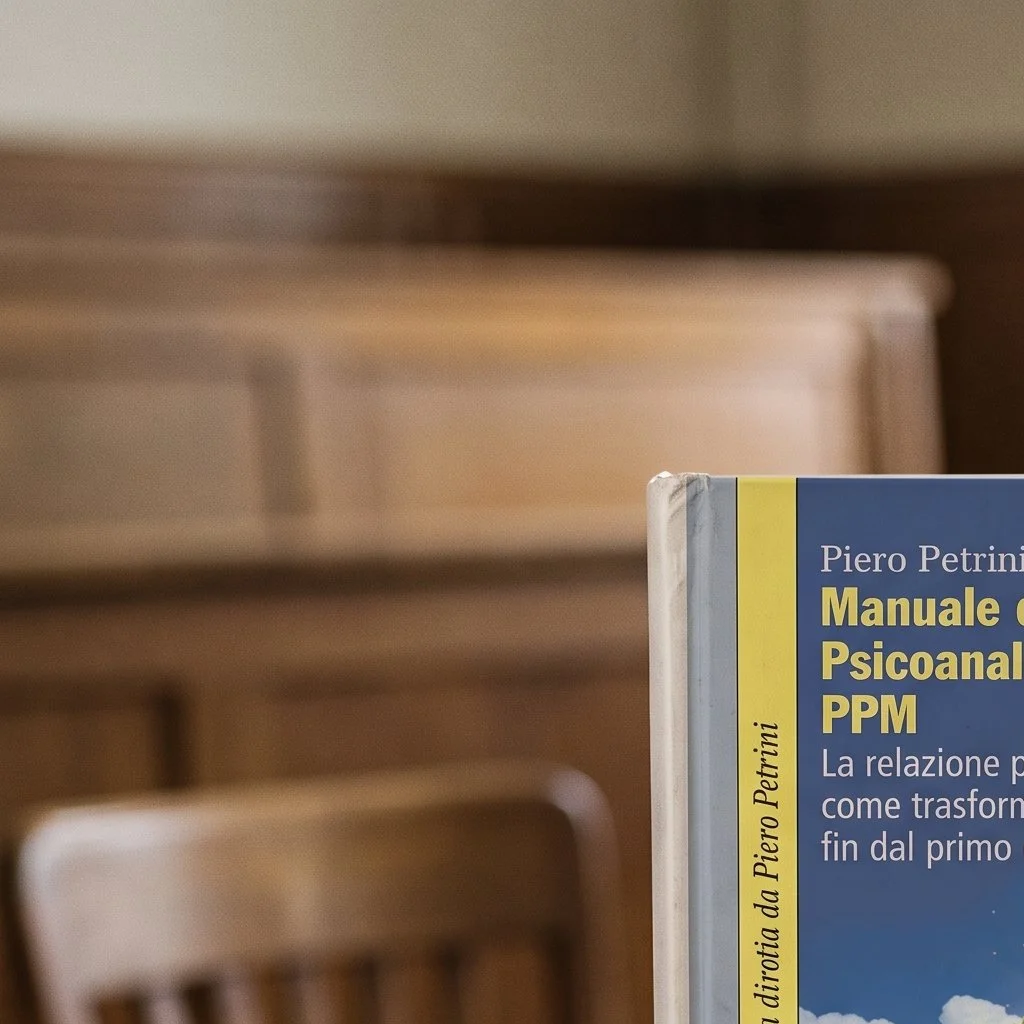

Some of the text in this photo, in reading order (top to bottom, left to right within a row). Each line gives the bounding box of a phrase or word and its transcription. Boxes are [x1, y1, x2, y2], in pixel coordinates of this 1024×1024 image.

[821, 545, 906, 573] Piero
[821, 586, 1000, 627] Manuale
[822, 694, 917, 734] PPM
[752, 721, 779, 809] Petrini
[822, 748, 854, 778] La
[866, 746, 1000, 778] relazione
[821, 797, 901, 820] come
[752, 815, 779, 883] Piero
[821, 830, 857, 861] fin
[870, 830, 914, 861] dal
[927, 831, 1012, 869] primo
[752, 889, 780, 919] da
